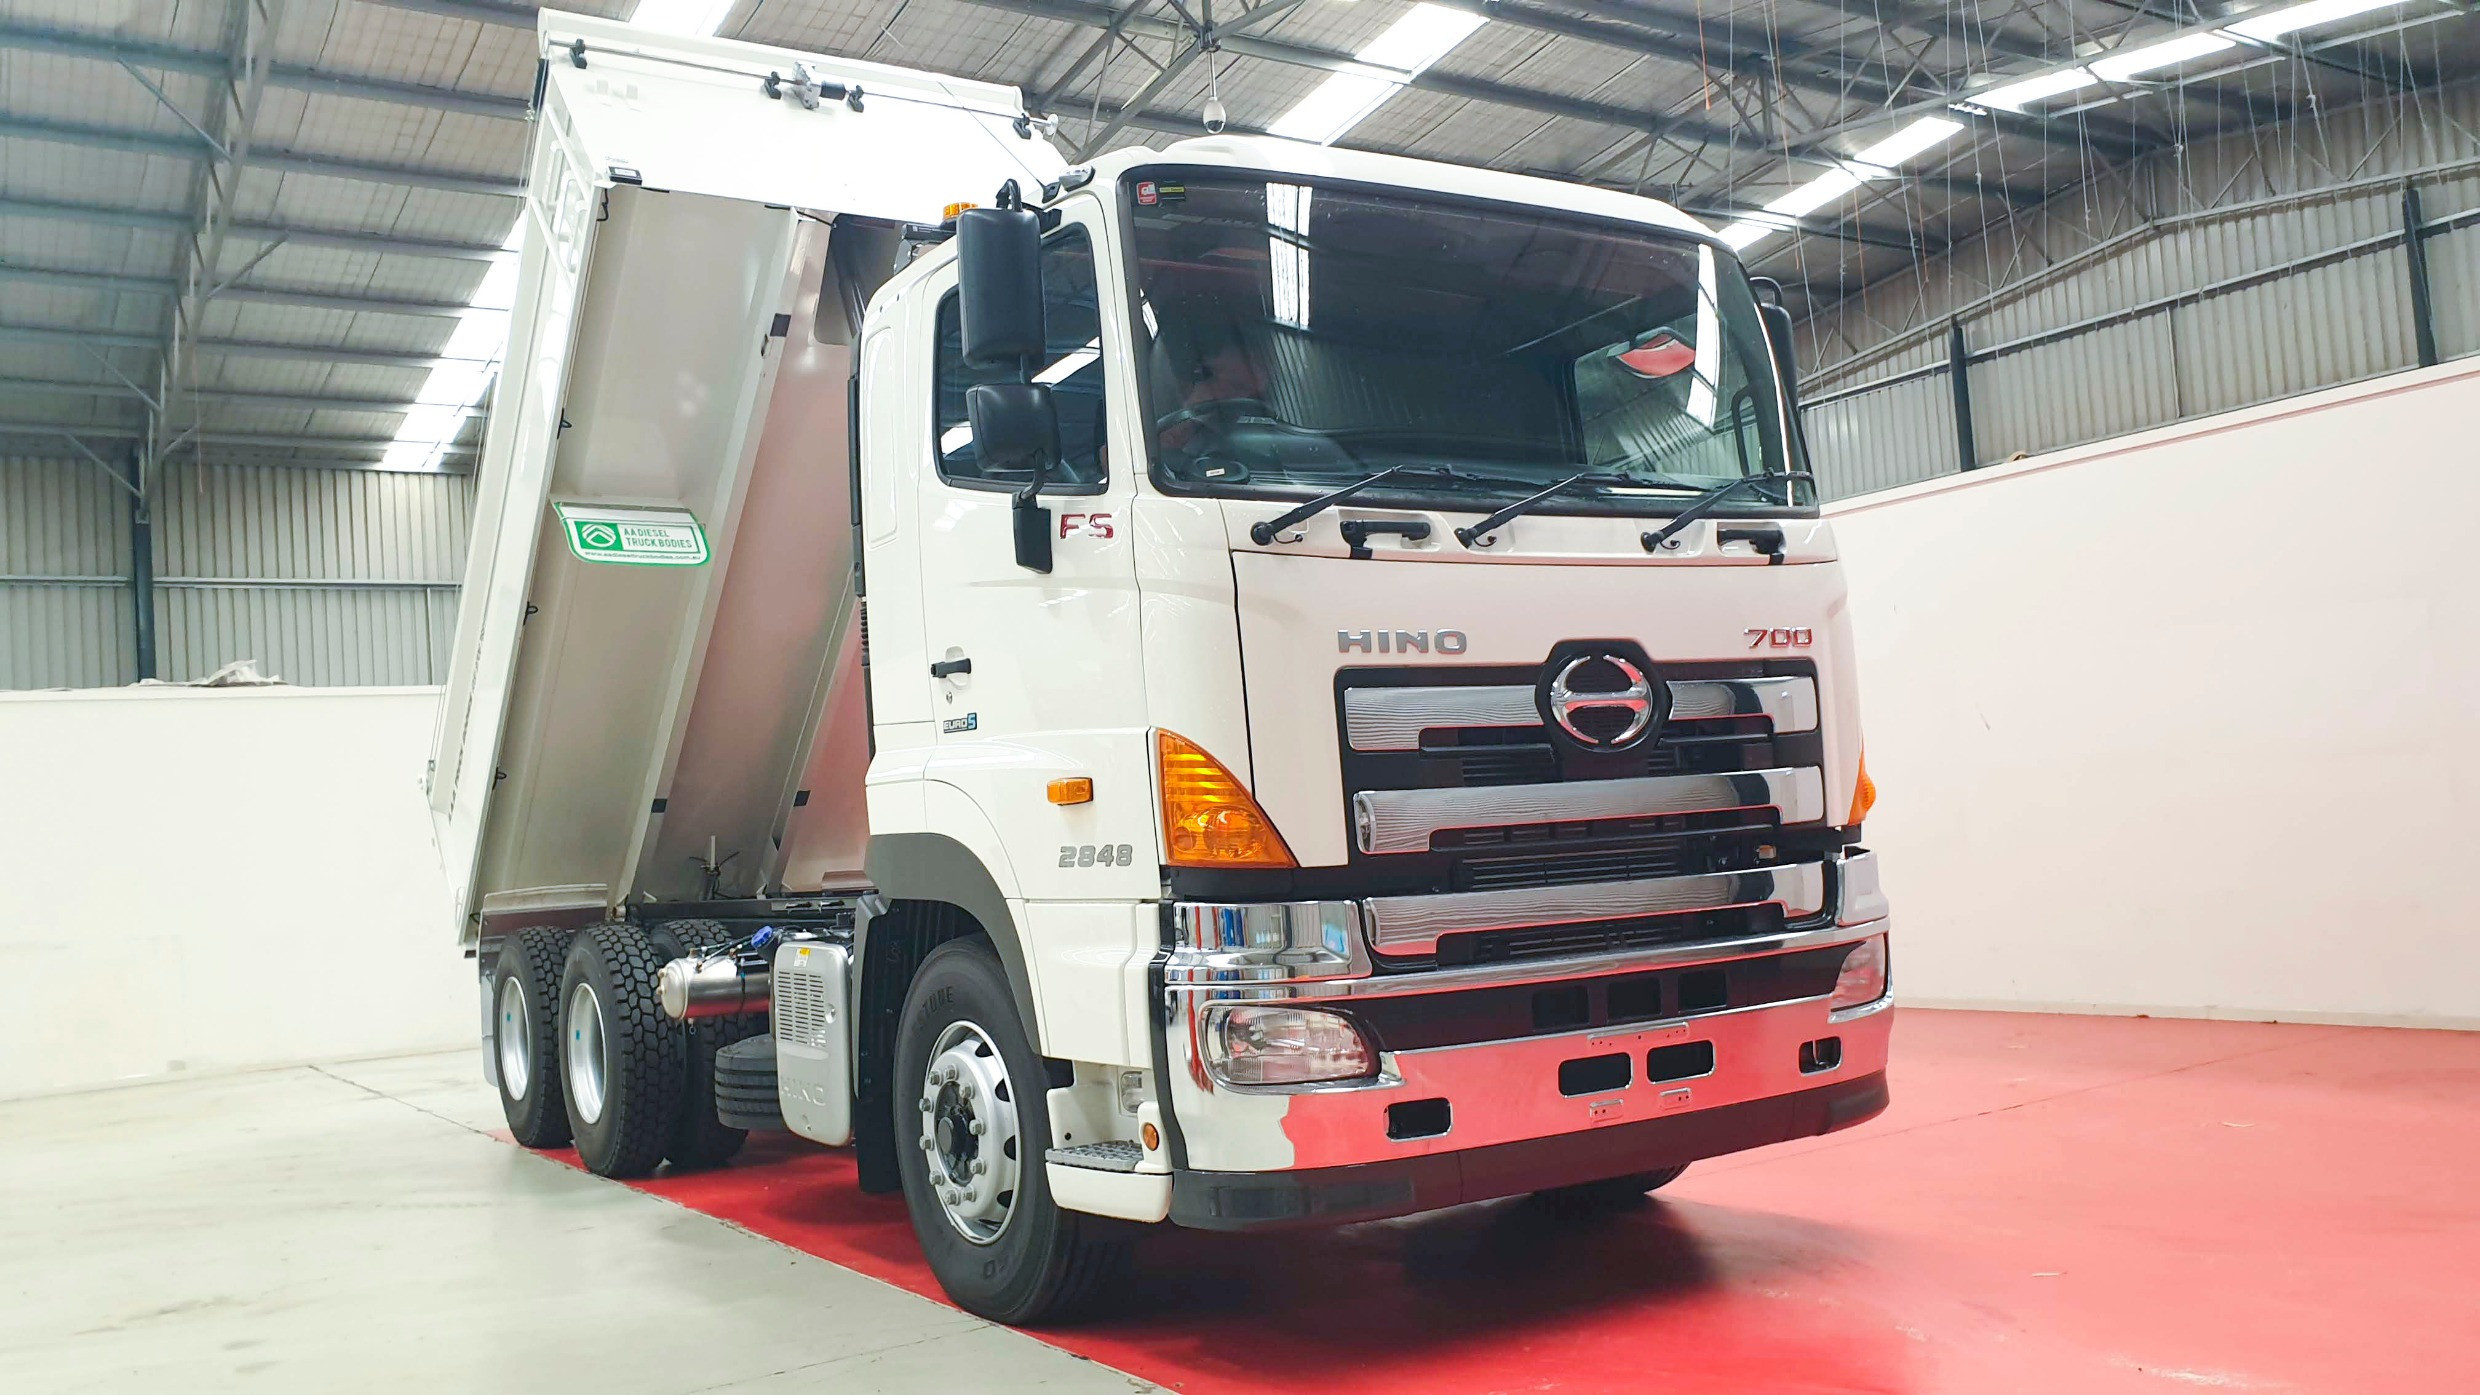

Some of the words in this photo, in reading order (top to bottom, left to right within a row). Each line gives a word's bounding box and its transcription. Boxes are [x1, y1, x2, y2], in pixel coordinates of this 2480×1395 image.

[624, 528, 637, 536] AA
[637, 529, 670, 538] DIESEL
[1060, 513, 1114, 539] FS
[626, 538, 659, 548] TRUCK
[659, 539, 693, 548] BODIES
[1337, 629, 1468, 655] HINO
[1744, 627, 1813, 649] 700
[1058, 844, 1133, 868] 2848
